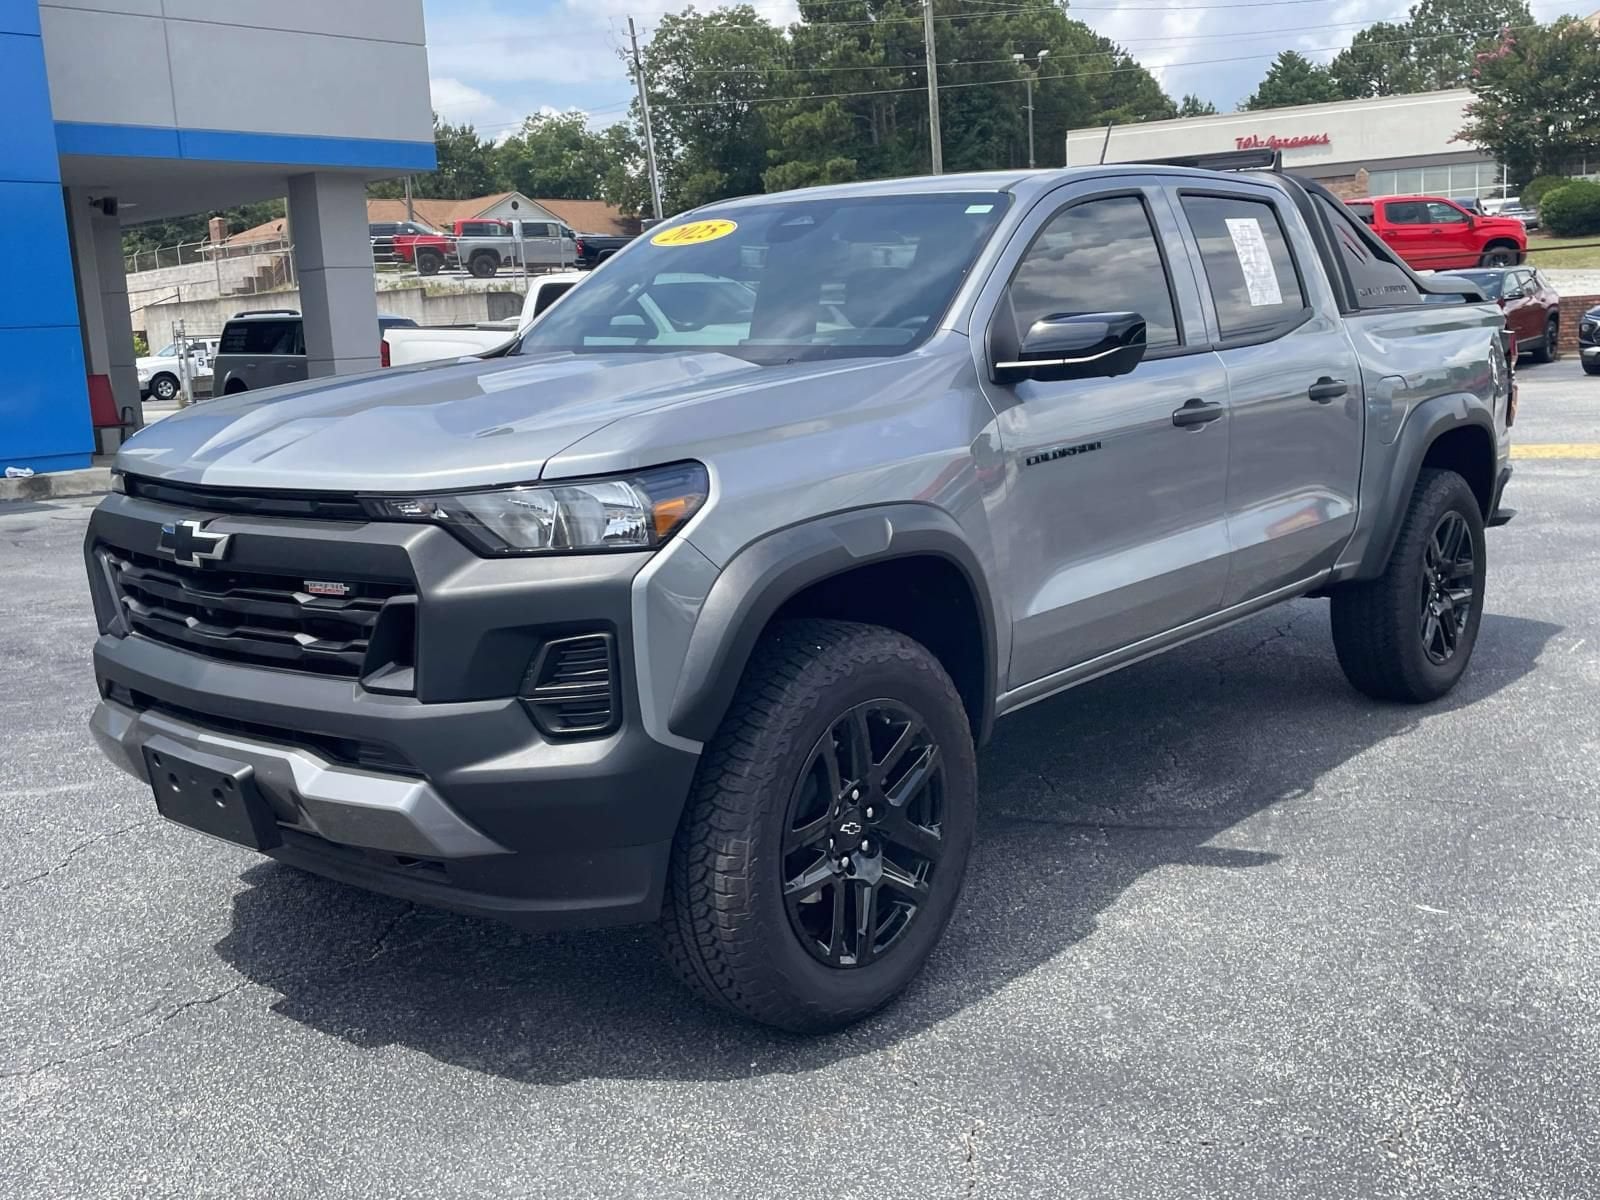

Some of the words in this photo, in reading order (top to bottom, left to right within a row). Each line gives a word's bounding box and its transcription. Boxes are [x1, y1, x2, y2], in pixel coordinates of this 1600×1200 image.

[1235, 133, 1331, 150] Walgreens
[658, 223, 729, 242] 2025
[198, 357, 205, 366] 5
[1026, 441, 1102, 466] COLORADO
